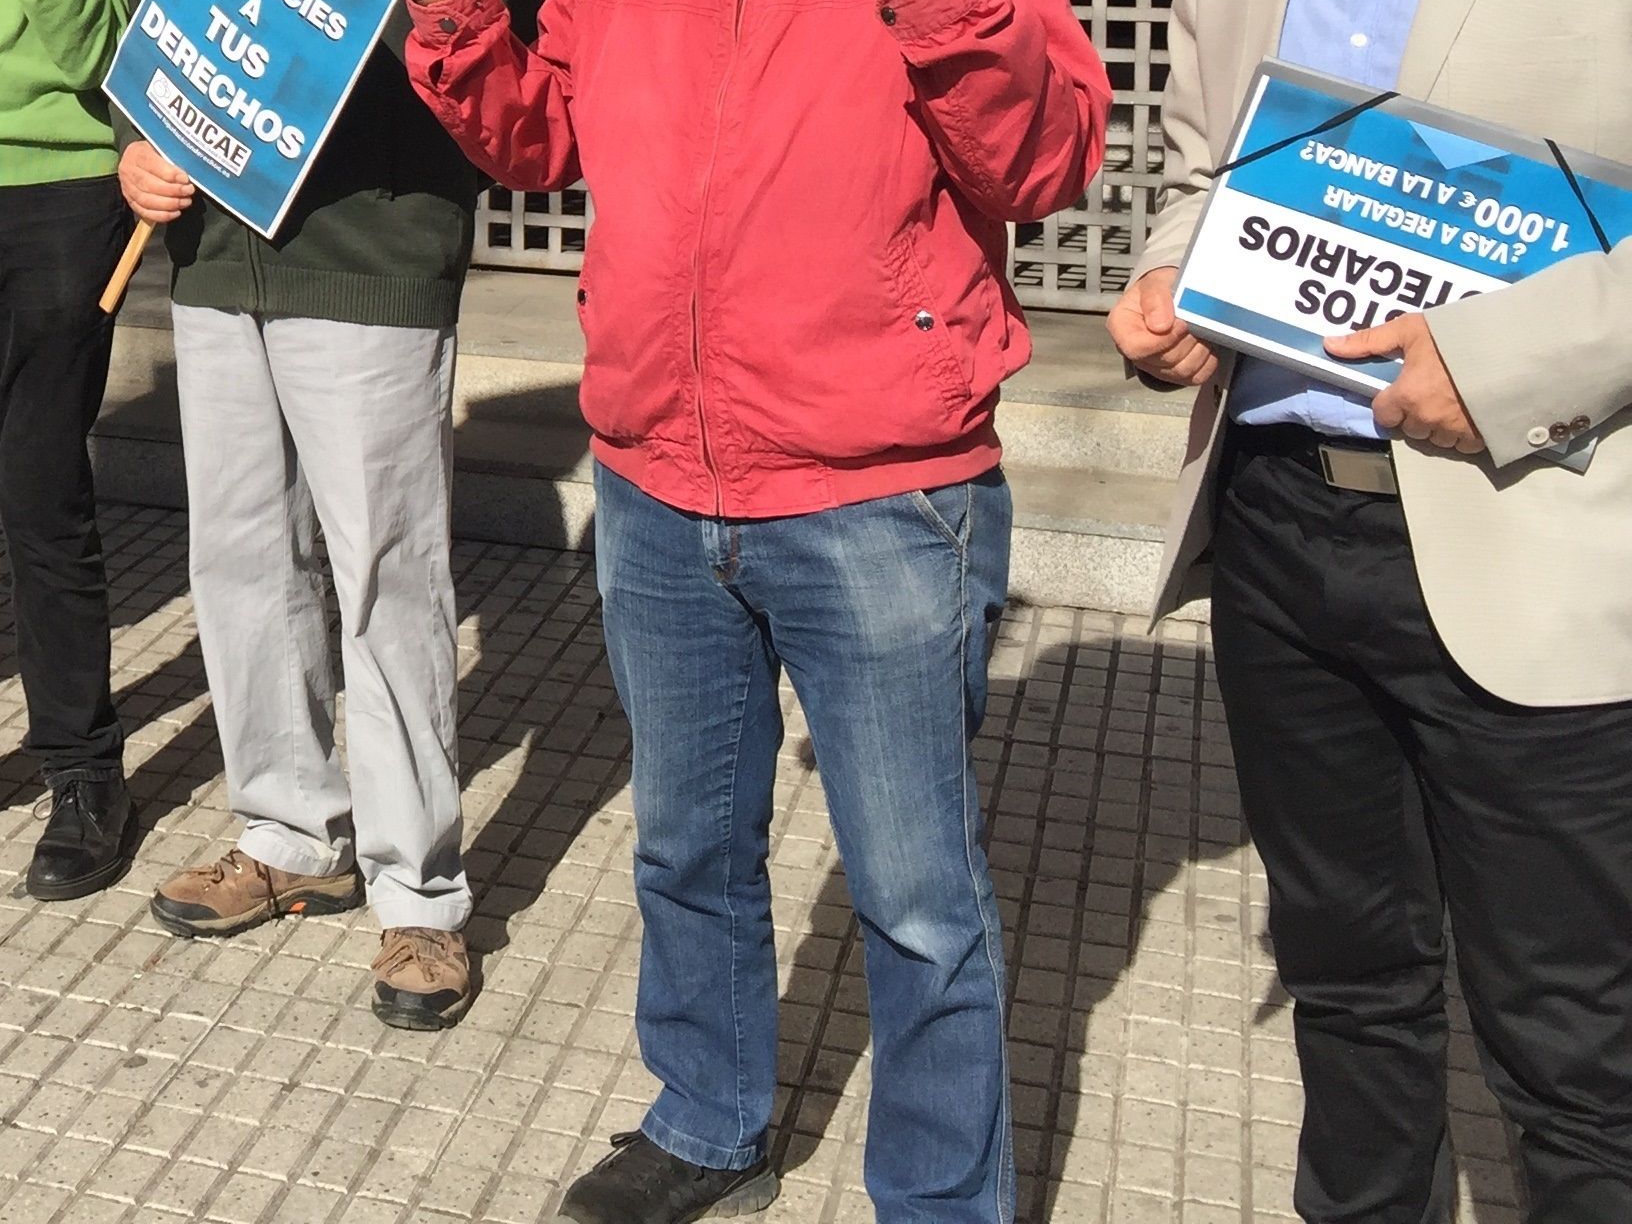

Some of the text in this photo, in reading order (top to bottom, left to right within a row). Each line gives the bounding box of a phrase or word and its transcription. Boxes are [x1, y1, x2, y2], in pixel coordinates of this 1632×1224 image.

[205, 5, 269, 79] TUS
[140, 2, 306, 160] DERECHOS
[168, 95, 247, 167] ADICAE
[1300, 140, 1393, 188] BANCA?
[1401, 170, 1432, 197] LA
[1437, 182, 1457, 205] A
[1323, 184, 1527, 264] ¿VAS A REGALAR
[1238, 215, 1482, 310] TECARIOS
[1294, 279, 1407, 332] TOS
